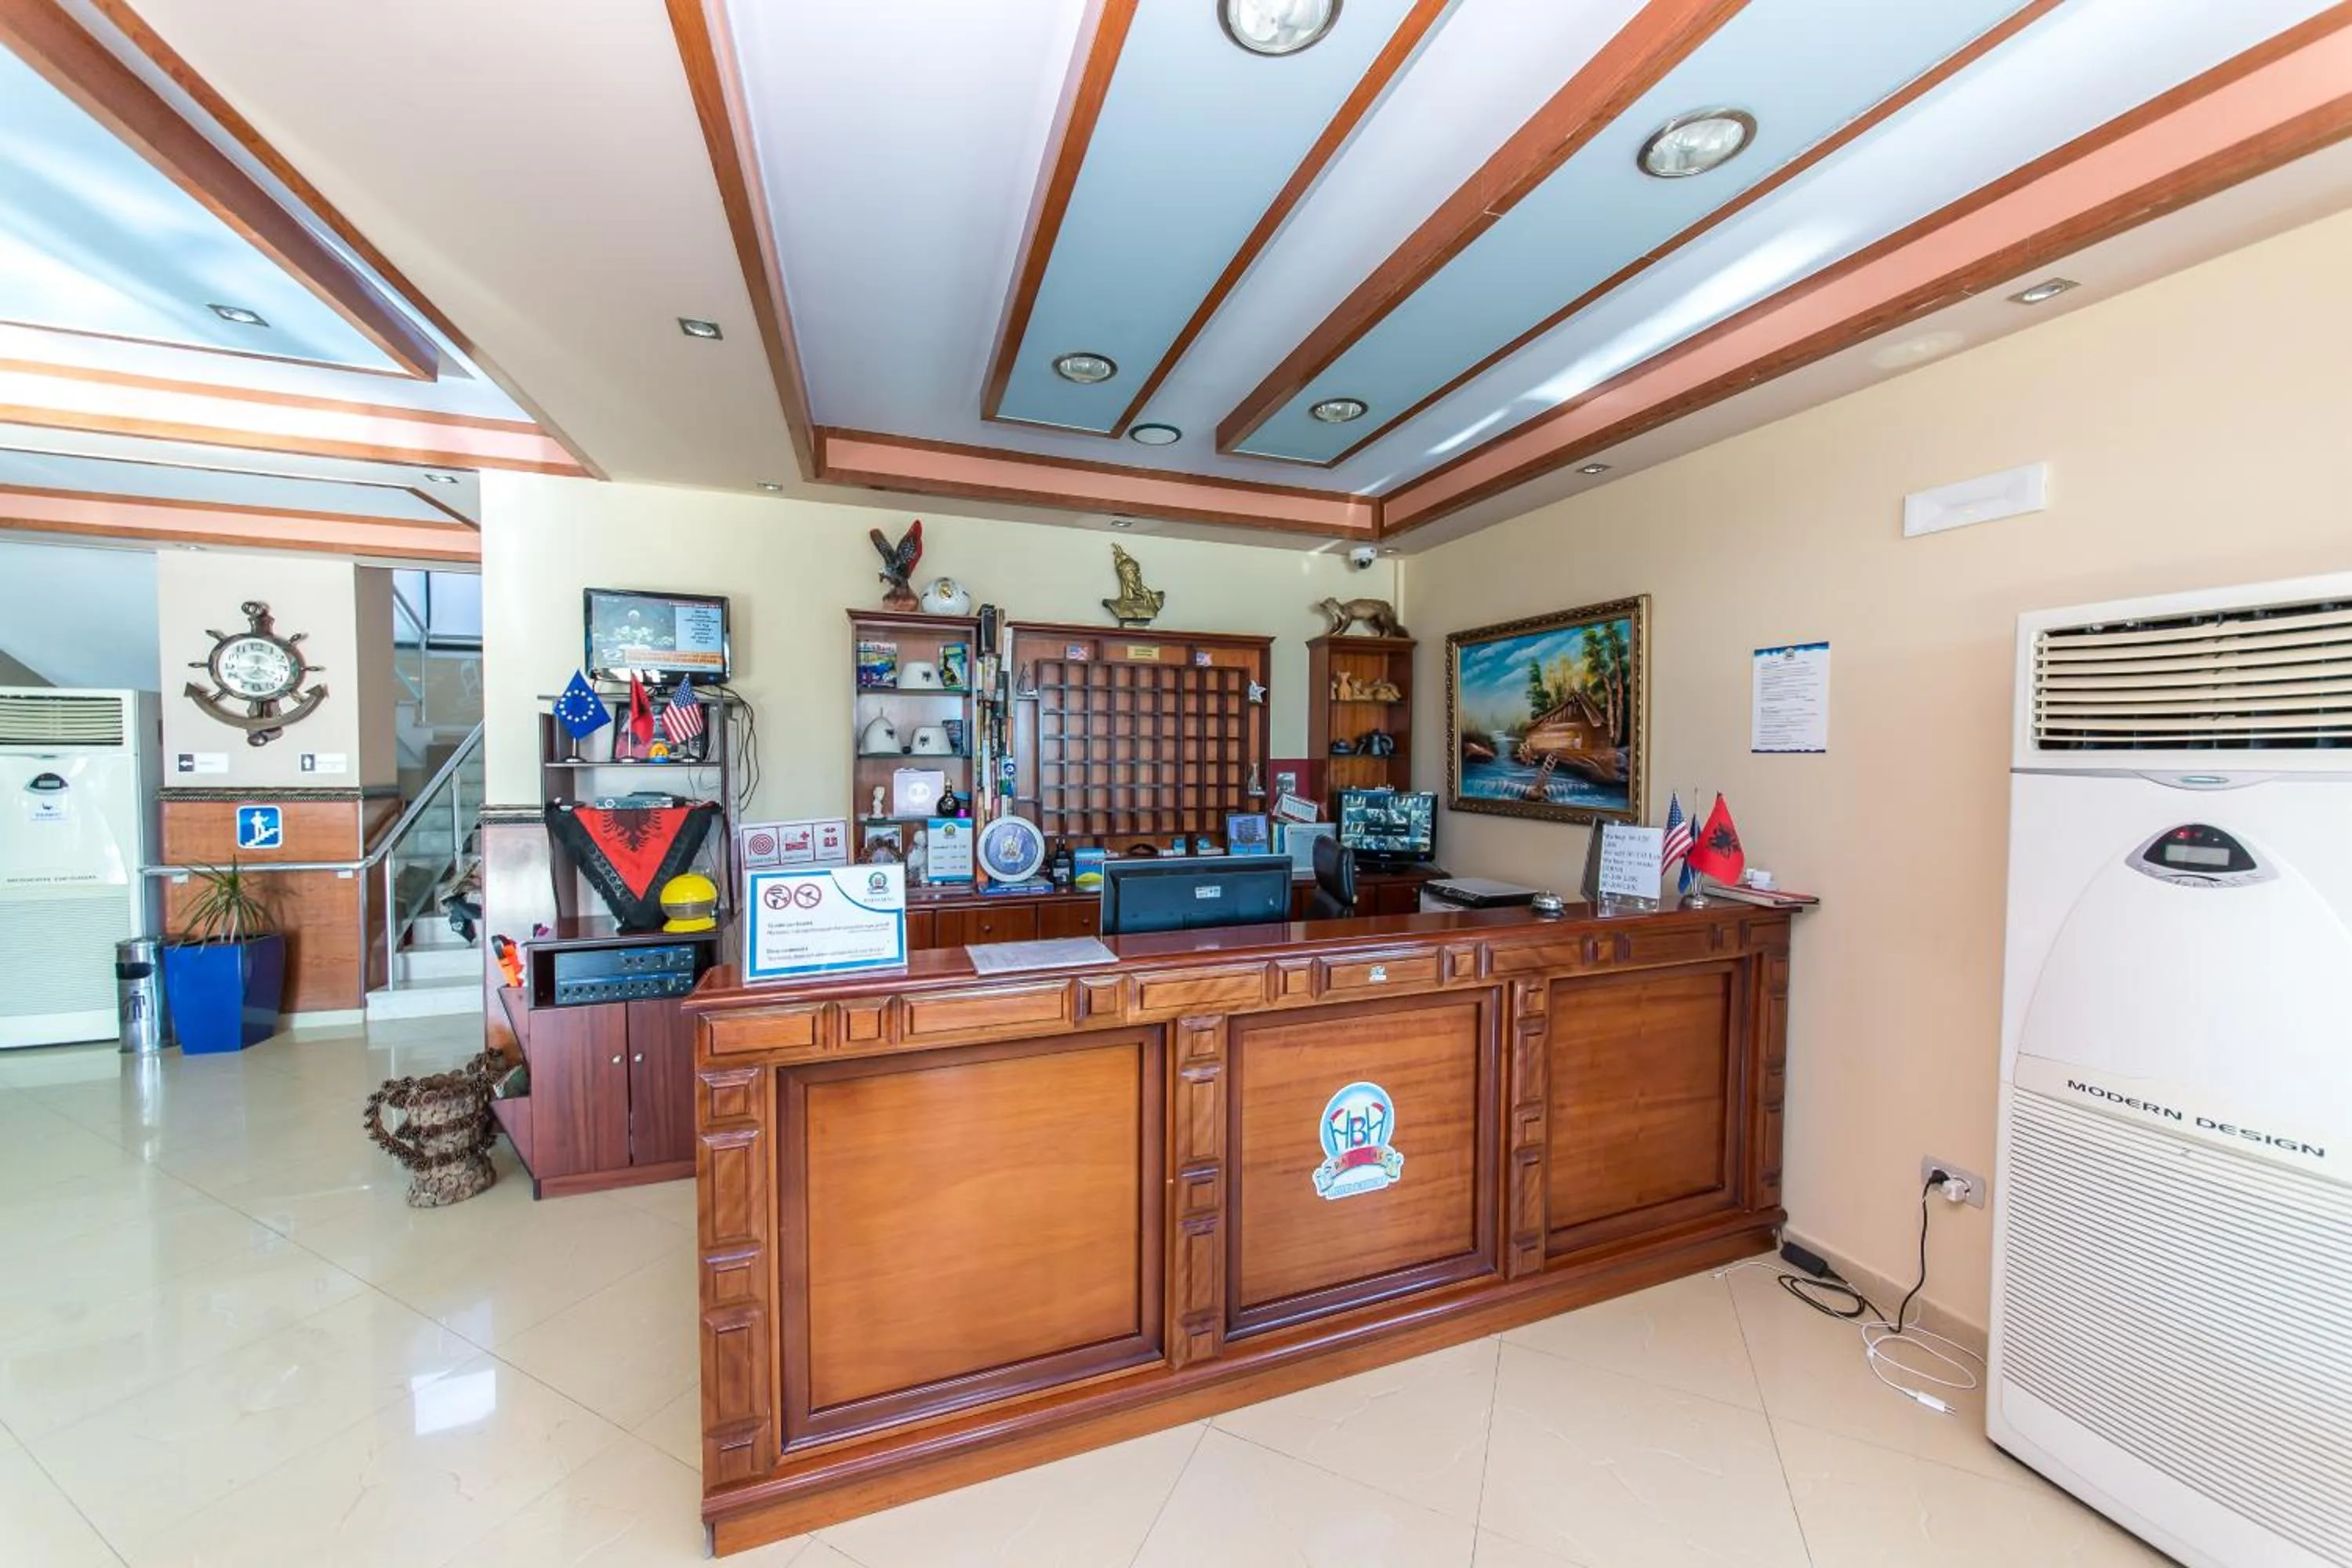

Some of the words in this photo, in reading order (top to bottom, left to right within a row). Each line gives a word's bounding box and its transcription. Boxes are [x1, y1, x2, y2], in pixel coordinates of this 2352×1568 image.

[1329, 1107, 1386, 1151] HBH
[2067, 1079, 2183, 1120] MODERN
[2195, 1117, 2325, 1158] DESIGN
